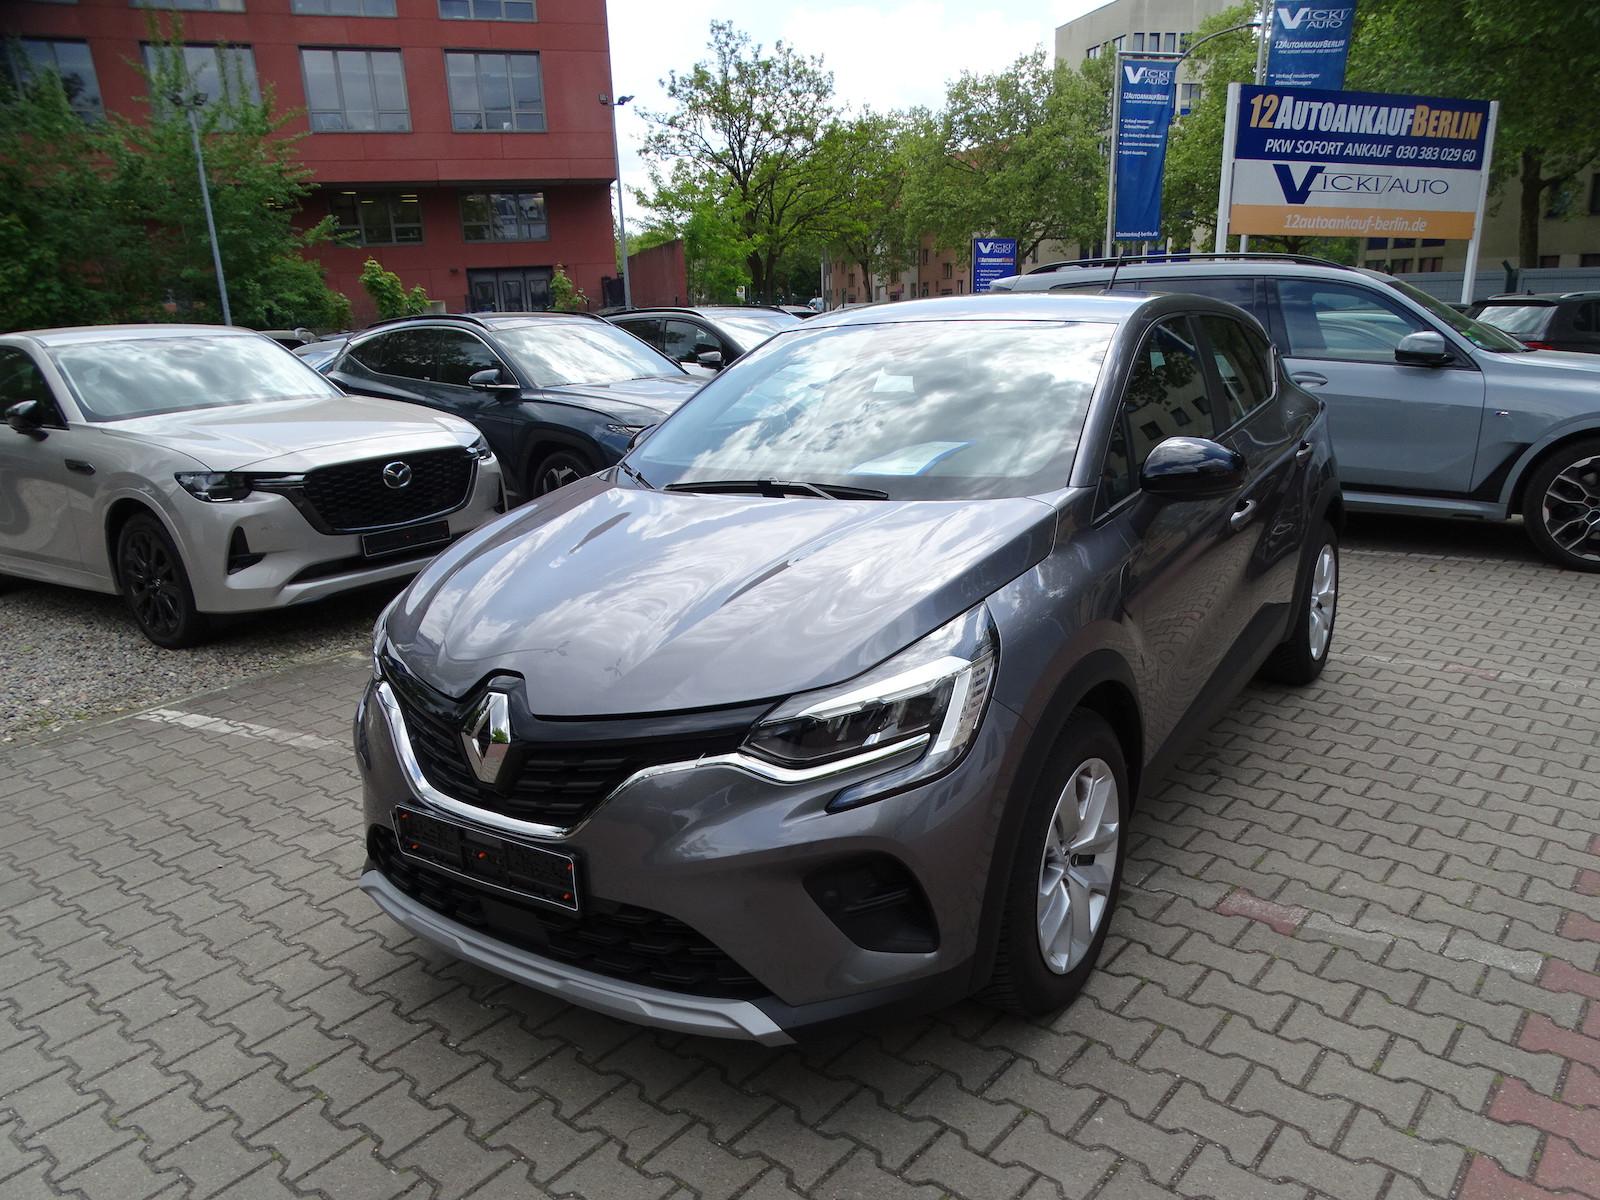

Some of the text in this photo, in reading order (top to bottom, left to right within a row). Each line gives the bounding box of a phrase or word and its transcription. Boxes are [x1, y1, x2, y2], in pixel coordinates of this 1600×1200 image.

[1305, 20, 1343, 29] AUTO
[1264, 138, 1476, 162] PKW SOFORT ANKAUF 030 383 029 60
[1387, 179, 1449, 195] AUTO
[1283, 213, 1427, 233] 12autoankauf-berlin.de
